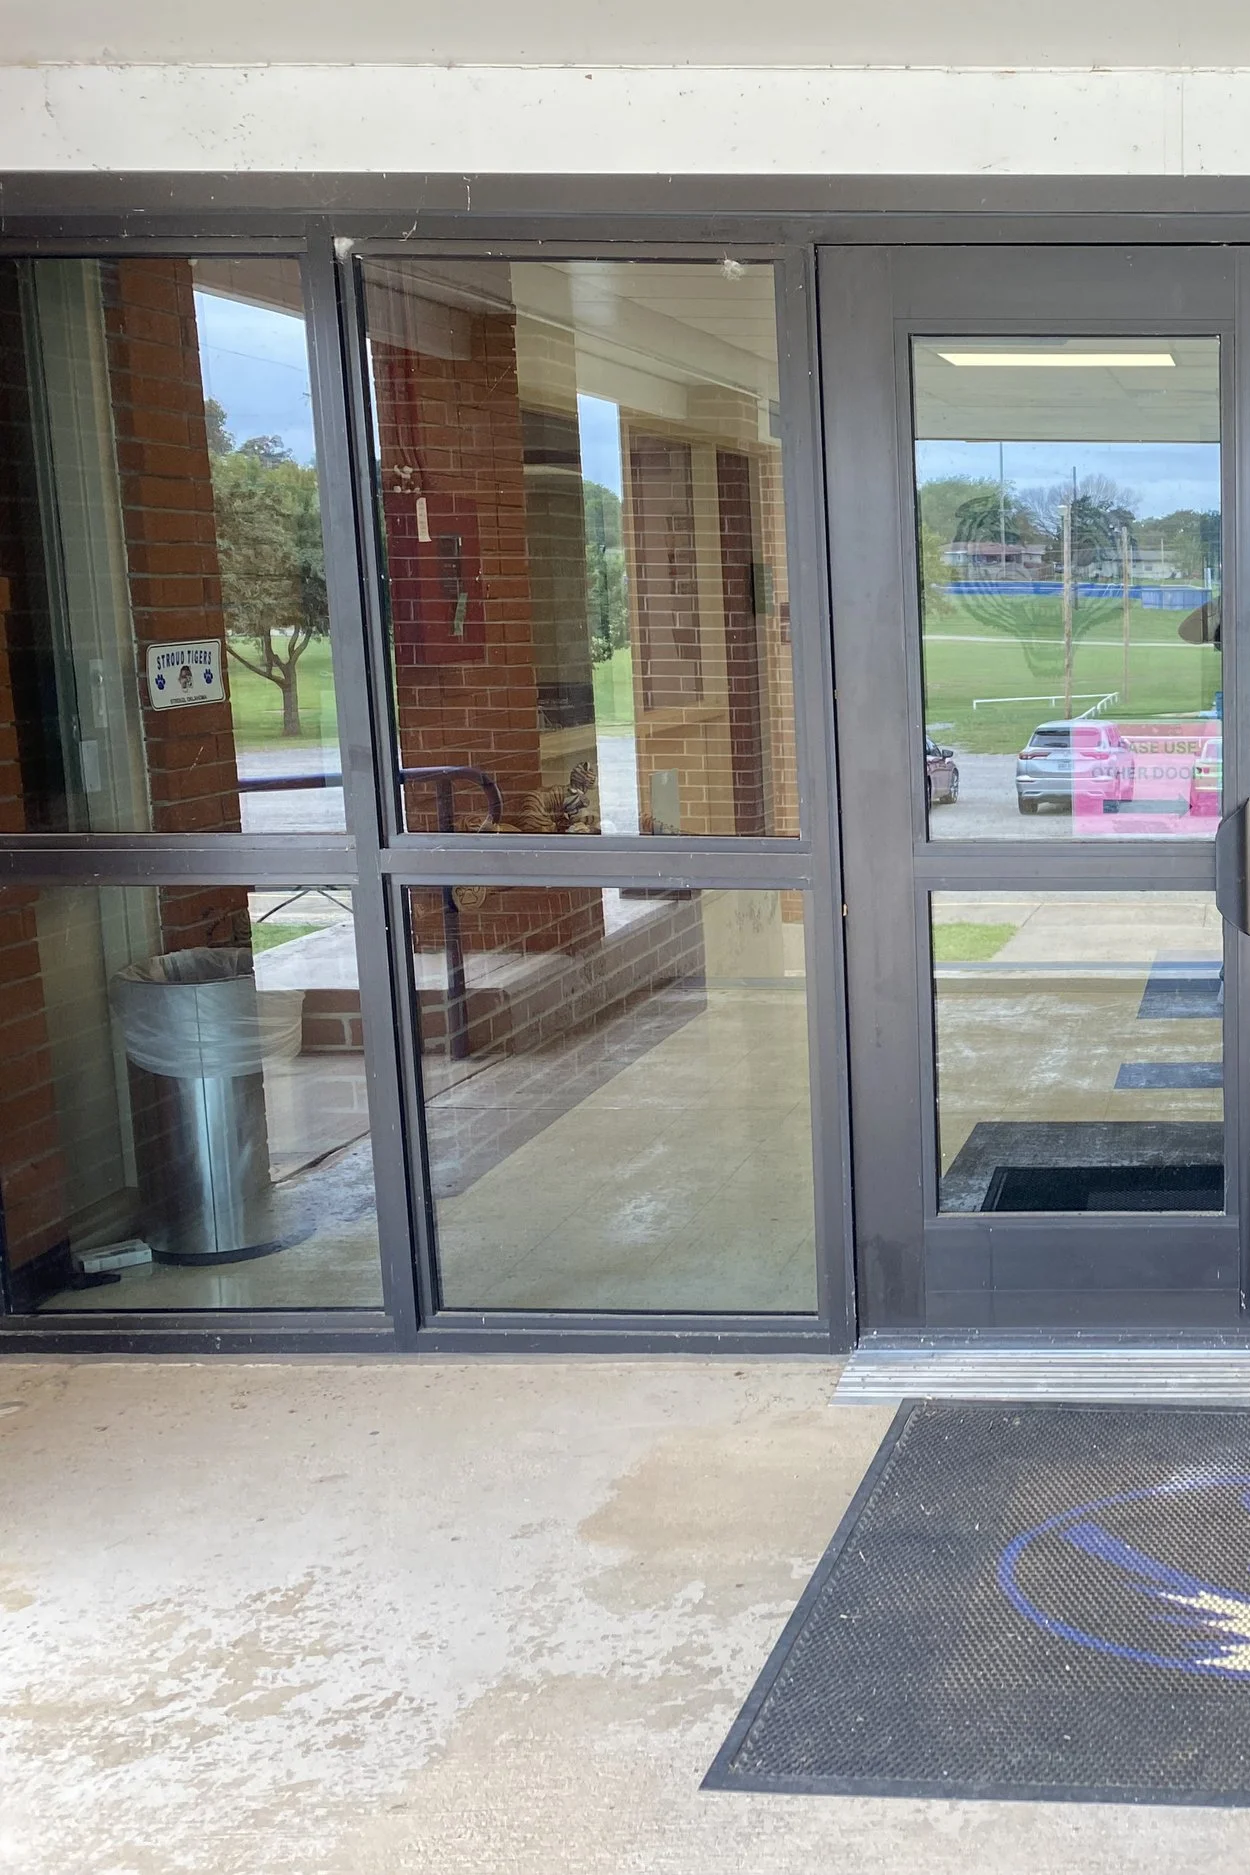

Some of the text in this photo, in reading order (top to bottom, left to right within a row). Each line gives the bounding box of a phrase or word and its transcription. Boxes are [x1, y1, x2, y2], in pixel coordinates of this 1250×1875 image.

[156, 650, 212, 670] STROUD TIGERS
[1163, 741, 1197, 755] USE
[1091, 766, 1149, 780] OTHER
